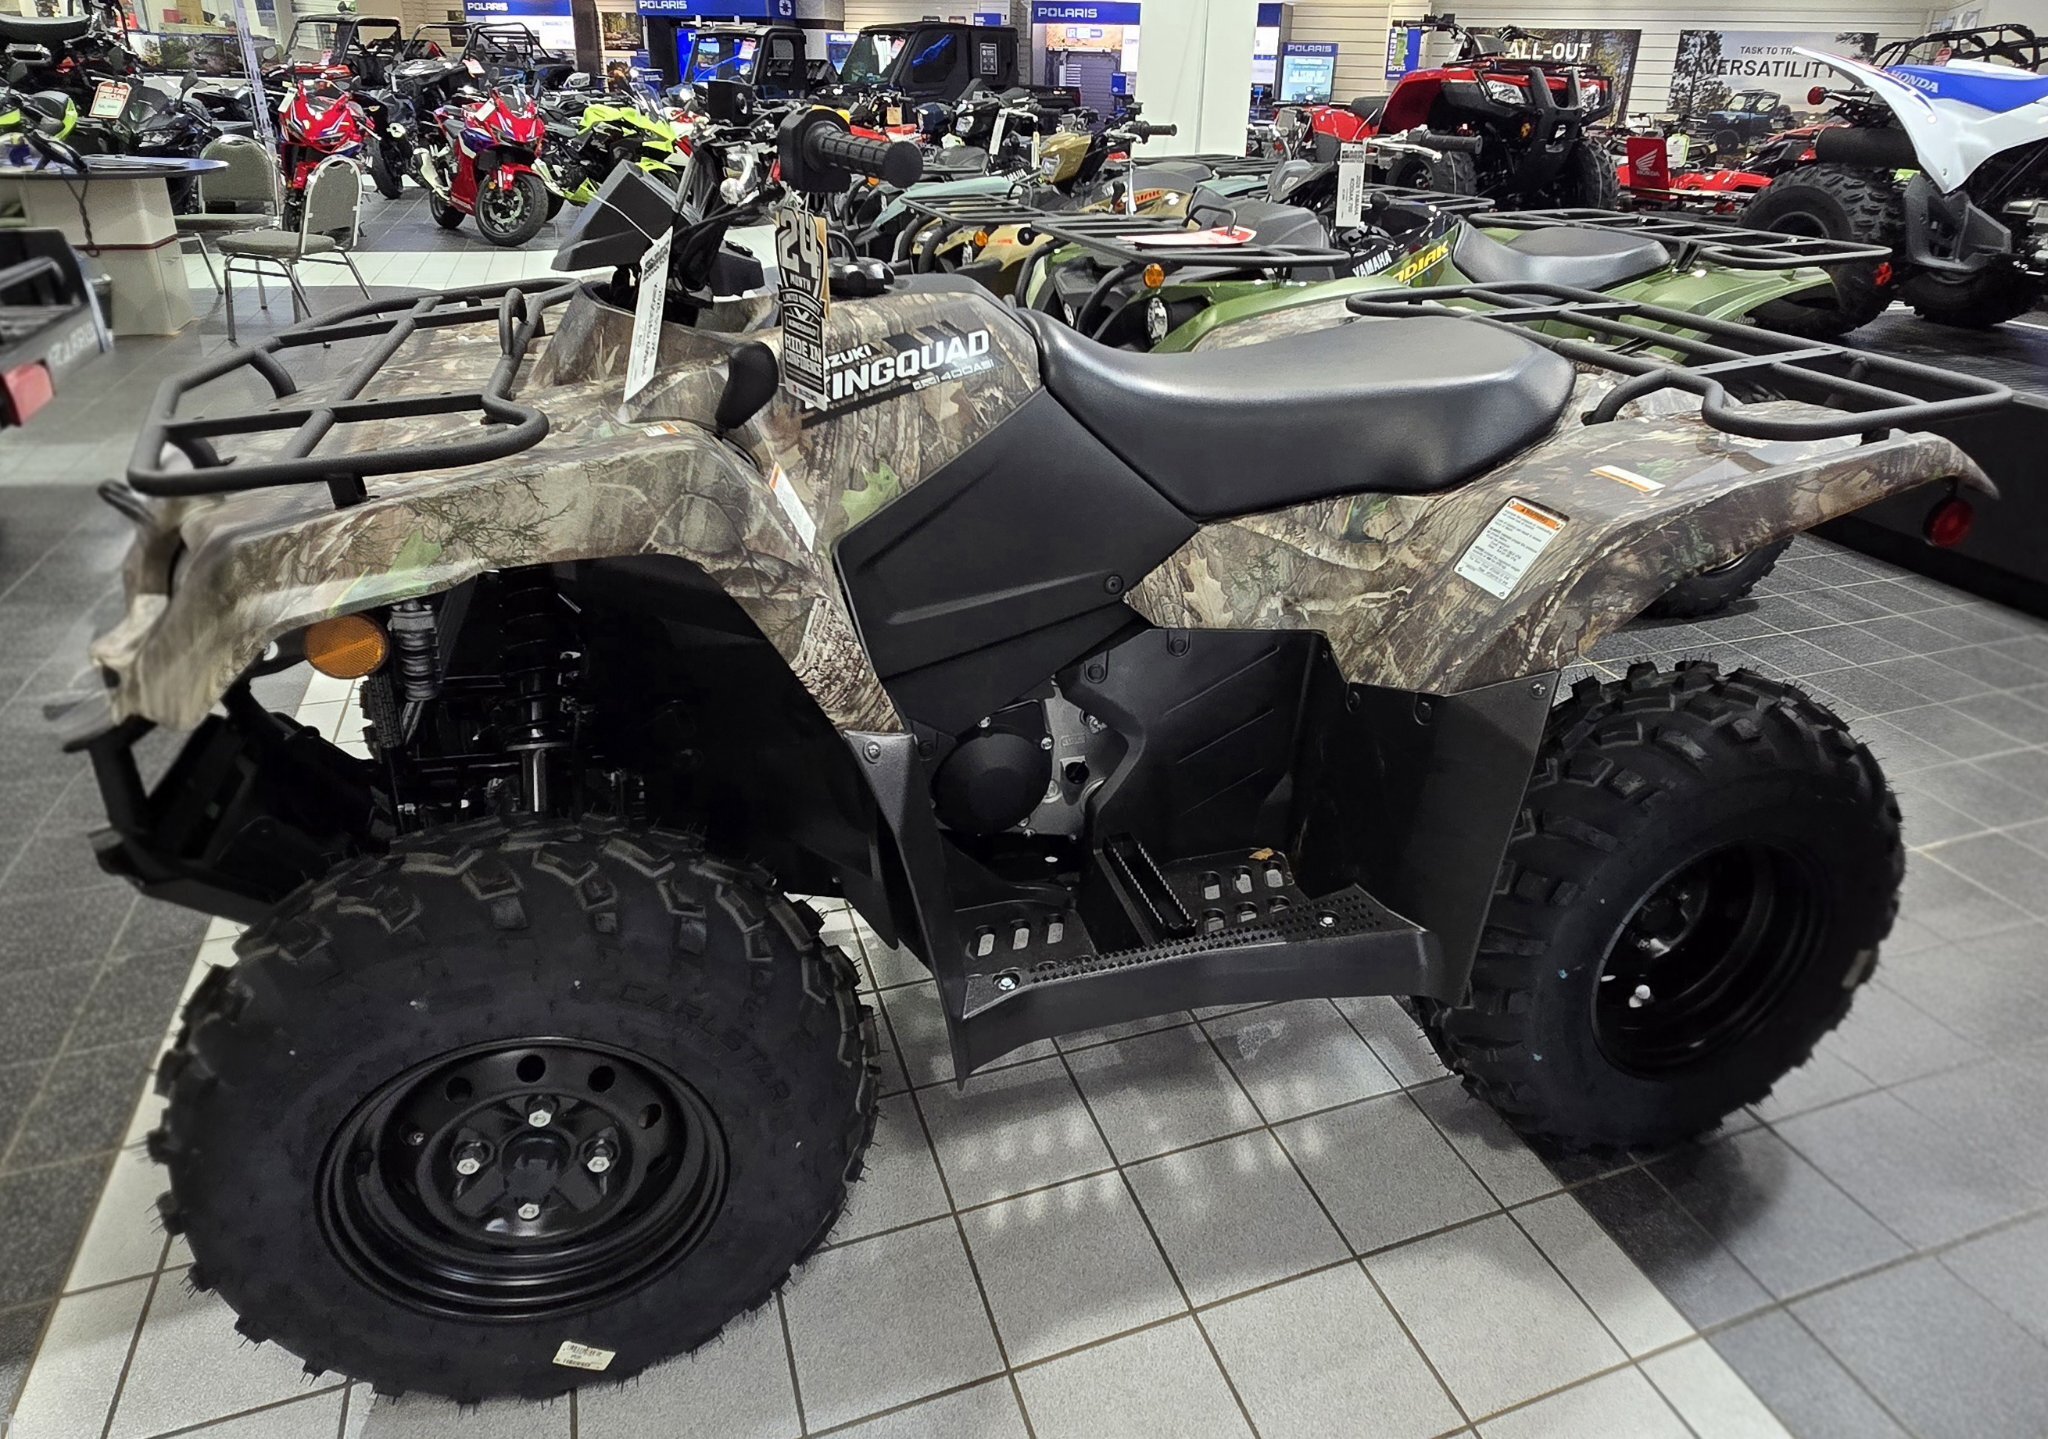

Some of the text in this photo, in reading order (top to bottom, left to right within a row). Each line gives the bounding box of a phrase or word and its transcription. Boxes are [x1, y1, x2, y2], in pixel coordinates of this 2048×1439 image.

[467, 2, 509, 11] POLARIS
[639, 0, 688, 10] POLARIS
[1037, 7, 1098, 18] POLARIS
[1287, 44, 1332, 53] POLARIS
[1506, 39, 1592, 60] ALL-OUT
[1740, 46, 1797, 55] TASK TO TR
[1704, 59, 1834, 78] VERSATILITY
[1891, 70, 1940, 94] HONDA
[779, 207, 821, 281] 24
[1352, 250, 1393, 278] YAMAHA
[1393, 240, 1449, 281] DIAK
[789, 273, 811, 292] MONTH
[784, 333, 822, 364] RIDE IN
[824, 344, 872, 370] ZUKI
